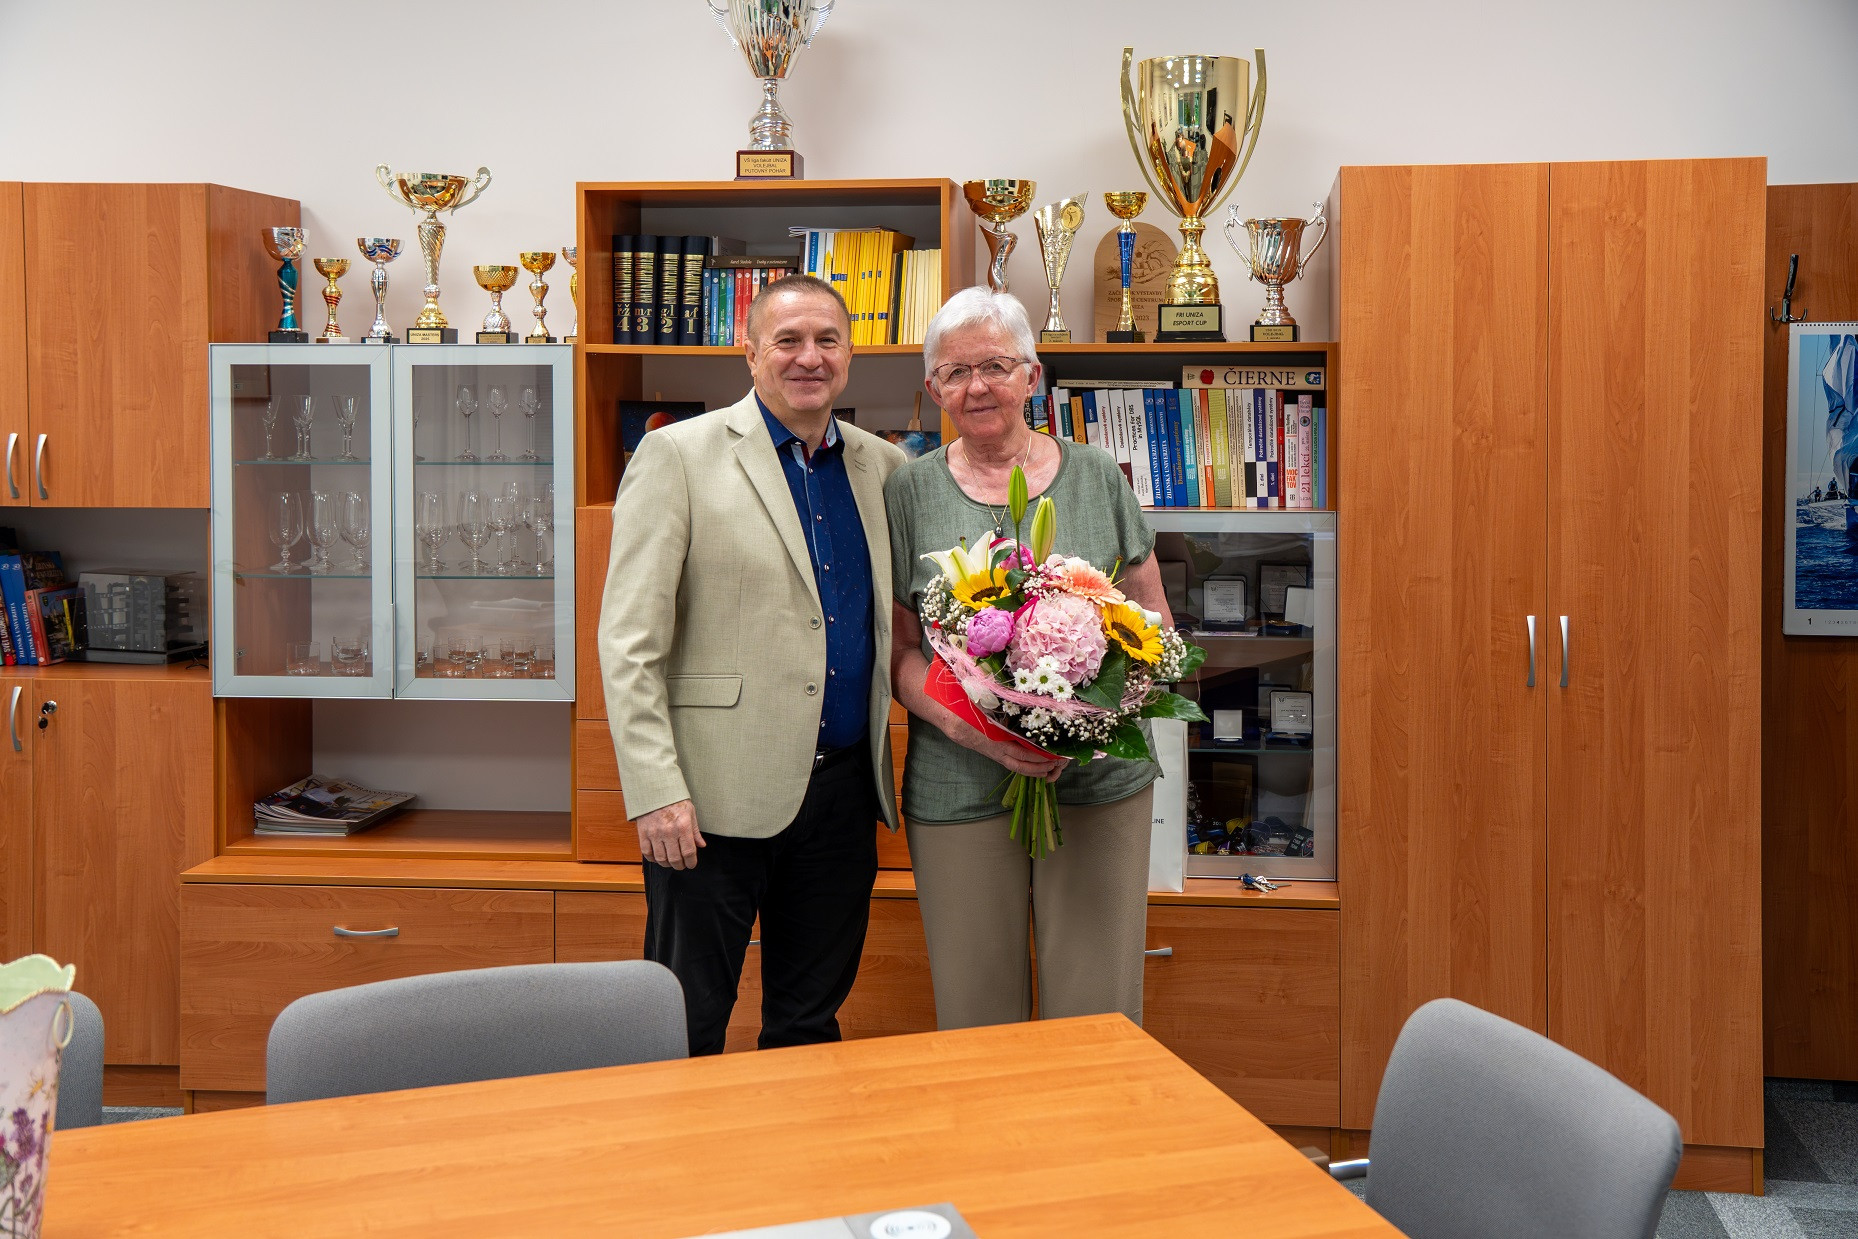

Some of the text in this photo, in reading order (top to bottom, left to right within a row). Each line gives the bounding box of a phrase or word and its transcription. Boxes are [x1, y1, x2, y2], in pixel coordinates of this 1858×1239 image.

[617, 317, 630, 332] 4
[637, 317, 649, 332] 3
[661, 318, 673, 334] 2
[687, 319, 695, 334] 1
[1224, 367, 1296, 386] ČIERNE
[1151, 440, 1159, 473] UNIVERZITA
[1162, 440, 1170, 473] UNIVERZITA
[1175, 447, 1183, 485] Databázové
[1300, 453, 1310, 493] 21 lekcí
[10, 602, 25, 658] ŽILINSKÁ UNIVERZITA
[22, 602, 36, 658] ŽILINSKÁ UNIVERZITA
[2, 638, 11, 652] SVET
